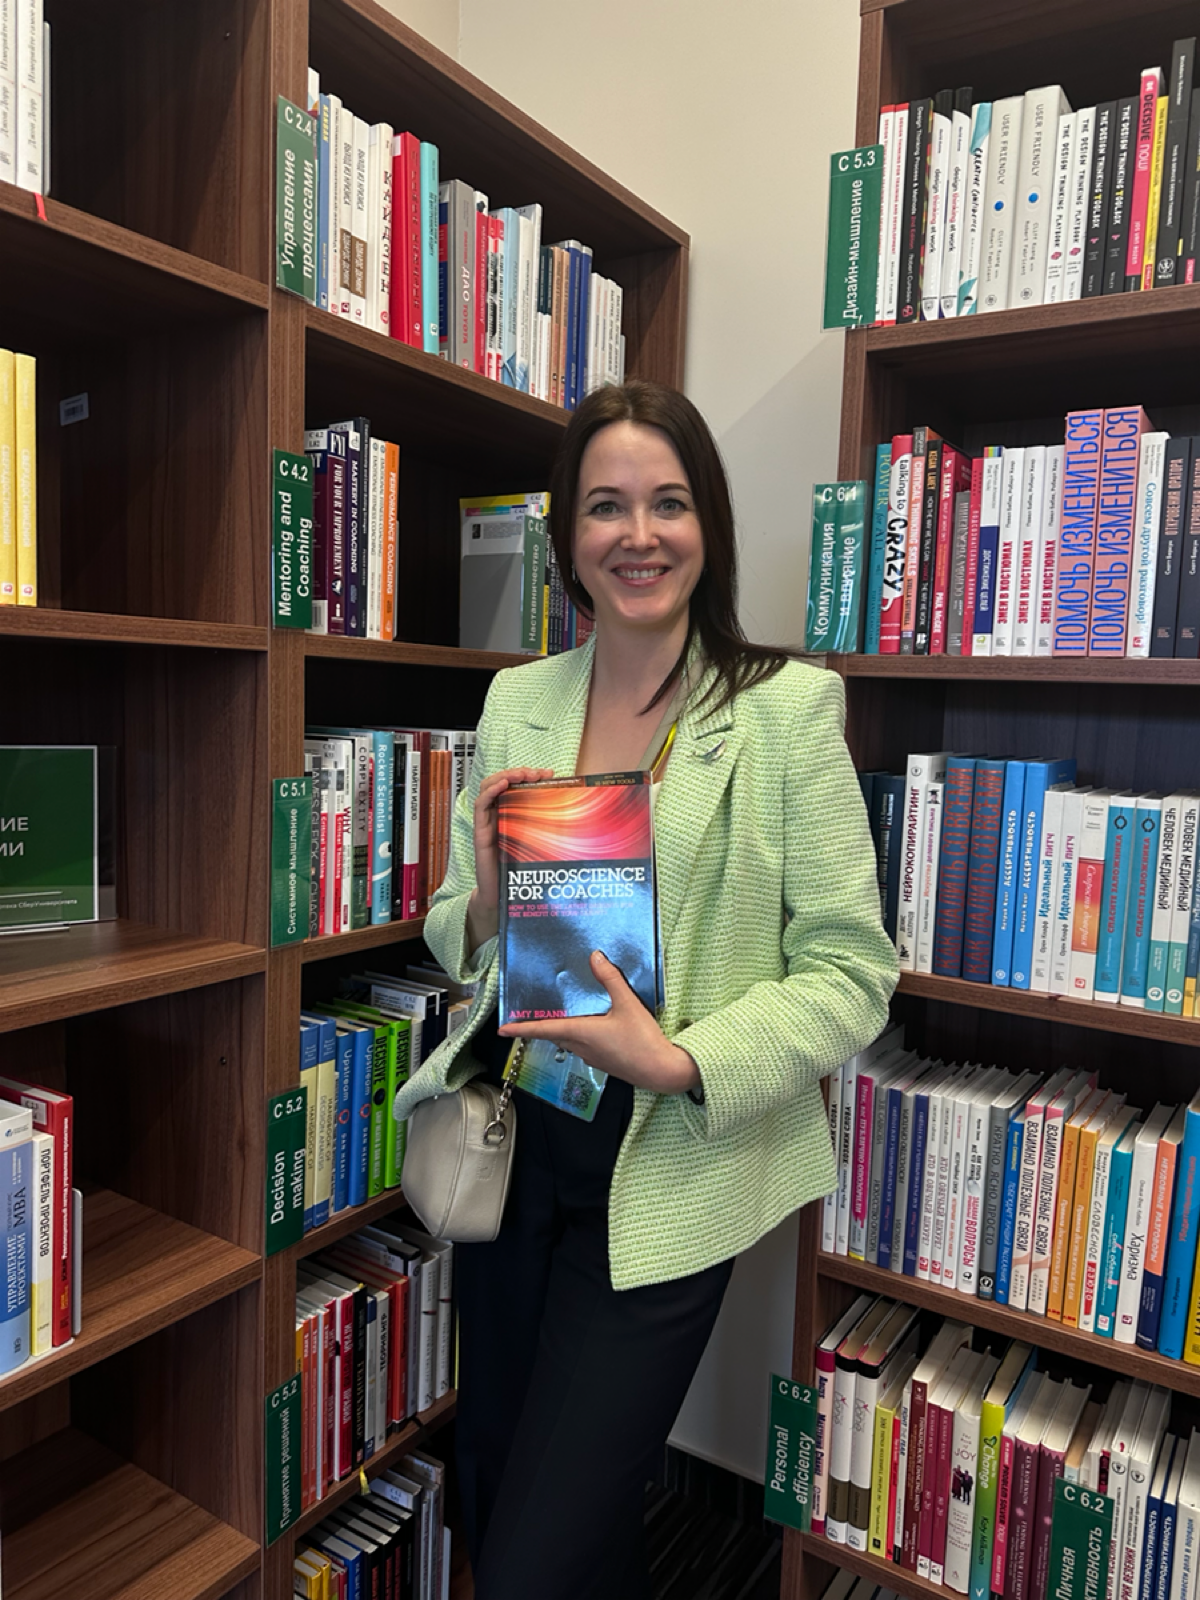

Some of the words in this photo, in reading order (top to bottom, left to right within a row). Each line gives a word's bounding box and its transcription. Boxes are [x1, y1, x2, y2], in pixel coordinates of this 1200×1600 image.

[1145, 81, 1153, 91] BE
[285, 107, 293, 124] C
[296, 113, 312, 136] 2.4
[1034, 104, 1044, 127] USER
[1100, 111, 1108, 127] THE
[1140, 94, 1153, 141] DECISIVE
[838, 156, 848, 172] C
[852, 151, 875, 170] 5.3
[914, 129, 922, 155] Thinking
[1031, 131, 1042, 177] FRIENDLY
[1098, 128, 1108, 154] DESIGN
[1137, 144, 1151, 171] NOW!
[951, 167, 961, 192] design
[1094, 156, 1105, 193] THINKING
[281, 149, 296, 268] Управление
[301, 159, 315, 278] процессами
[949, 193, 959, 223] thinking
[950, 224, 957, 232] at
[1092, 193, 1102, 228] TOOLBOX
[843, 179, 863, 319] Дизайн-мышление
[948, 233, 956, 252] work
[461, 266, 470, 302] ДАО
[280, 460, 288, 476] C
[291, 464, 308, 481] 4.2
[333, 464, 342, 483] FOR
[897, 459, 907, 496] talking
[911, 461, 922, 501] CRITICAL
[1097, 409, 1140, 556] ИЗМЕНИТЬСЯ
[1170, 459, 1184, 488] ОРАТОРА
[279, 491, 291, 525] and
[334, 485, 342, 509] YOUR
[351, 507, 357, 519] IN
[387, 472, 396, 542] PERFORMANCE
[823, 487, 832, 502] C
[837, 487, 856, 501] 6.1
[897, 498, 905, 510] to
[1143, 482, 1156, 525] Совсем
[1164, 490, 1181, 536] ОТКРОВЕНИЯ
[333, 511, 342, 577] IMPROVEMENT
[528, 520, 534, 532] C
[535, 522, 545, 535] 4.2
[909, 503, 920, 545] THINKING
[297, 517, 312, 597] Coaching
[883, 518, 908, 592] CRAZY
[907, 546, 917, 576] SKILLS
[1000, 541, 1012, 591] КОСТЮМАХ
[1139, 527, 1154, 567] другой
[278, 530, 293, 616] Mentoring
[386, 543, 394, 595] COACHING
[814, 523, 835, 635] Коммуникация
[839, 537, 855, 601] влияние
[981, 549, 992, 589] ДОСТИЖЕНИЕ
[528, 544, 540, 641] Наставничество
[840, 608, 849, 616] и
[904, 598, 912, 626] COTTRELL
[980, 592, 989, 611] ЦЕЛЕЙ
[1090, 562, 1128, 651] ПОМОЧЬ
[1136, 569, 1150, 624] разговор!
[997, 603, 1008, 624] ЗМЕИ
[377, 744, 387, 782] Rocket
[280, 783, 288, 797] C
[291, 781, 306, 796] 5.1
[358, 747, 367, 832] COMPLEXITY
[376, 785, 386, 833] Scientist
[946, 767, 973, 828] ВСЕМИ
[289, 808, 297, 869] мышление
[342, 806, 351, 833] WHY
[1181, 808, 1196, 853] ЧЕЛОВЕК
[903, 786, 920, 903] НЕЙРОКОПИРАЙТИНГ
[943, 833, 968, 855] СО
[1044, 833, 1055, 857] питч
[1110, 834, 1124, 893] ЗАЛОЖНИКА
[508, 867, 645, 885] NEUROSCIENCE
[508, 886, 544, 901] FOR
[548, 883, 634, 899] COACHES
[936, 860, 967, 932] ЛАДИТЬ
[1038, 859, 1053, 918] Идеальный
[1176, 854, 1193, 912] МЕДИЙНЫЙ
[288, 873, 297, 934] Системное
[1107, 894, 1118, 933] СПАСИТЕ
[936, 936, 960, 969] КАК
[509, 1010, 531, 1018] AMY
[534, 1010, 567, 1018] BRANN
[395, 1029, 409, 1077] DECISIVE
[341, 1049, 351, 1101] Upstream
[274, 1104, 282, 1118] C
[285, 1096, 303, 1114] 5.2
[990, 1125, 1001, 1168] КРАТКО.
[1043, 1124, 1058, 1168] ВЗАИМНО
[40, 1149, 51, 1203] ПОРТФЕЛЬ
[271, 1151, 285, 1224] Decision
[291, 1148, 305, 1208] making
[988, 1171, 1000, 1202] ЯСНО.
[1039, 1171, 1054, 1221] ПОЛЕЗНЫЕ
[1155, 1157, 1168, 1209] НЕУДОБНЫЕ
[13, 1186, 26, 1228] MBA
[985, 1205, 997, 1245] ПРОСТО
[39, 1204, 51, 1257] ПРОЕКТОВ
[1035, 1224, 1049, 1256] СВЯЗИ
[1089, 1201, 1102, 1260] СЛОВЕСНОЕ
[1149, 1212, 1163, 1262] РАЗГОВОРЫ
[7, 1234, 17, 1313] УПРАВЛЕНИЕ
[16, 1232, 26, 1305] ПРОЕКТАМИ
[1127, 1233, 1144, 1281] Харизма
[1085, 1265, 1096, 1301] ДЗЮДО
[272, 1393, 280, 1407] C
[282, 1380, 298, 1399] 5.2
[779, 1381, 788, 1395] C
[792, 1386, 811, 1403] 6.2
[279, 1407, 291, 1463] решений
[771, 1425, 789, 1492] Personal
[793, 1432, 815, 1504] efficiency
[979, 1445, 993, 1489] Change
[280, 1465, 290, 1528] Принятие
[1064, 1486, 1075, 1501] C
[1080, 1492, 1104, 1513] 6.2
[980, 1516, 989, 1534] Katy
[978, 1535, 988, 1565] Milkman
[1123, 1547, 1136, 1584] ВЕЗЕНИЯ
[1056, 1547, 1075, 1600] Личная
